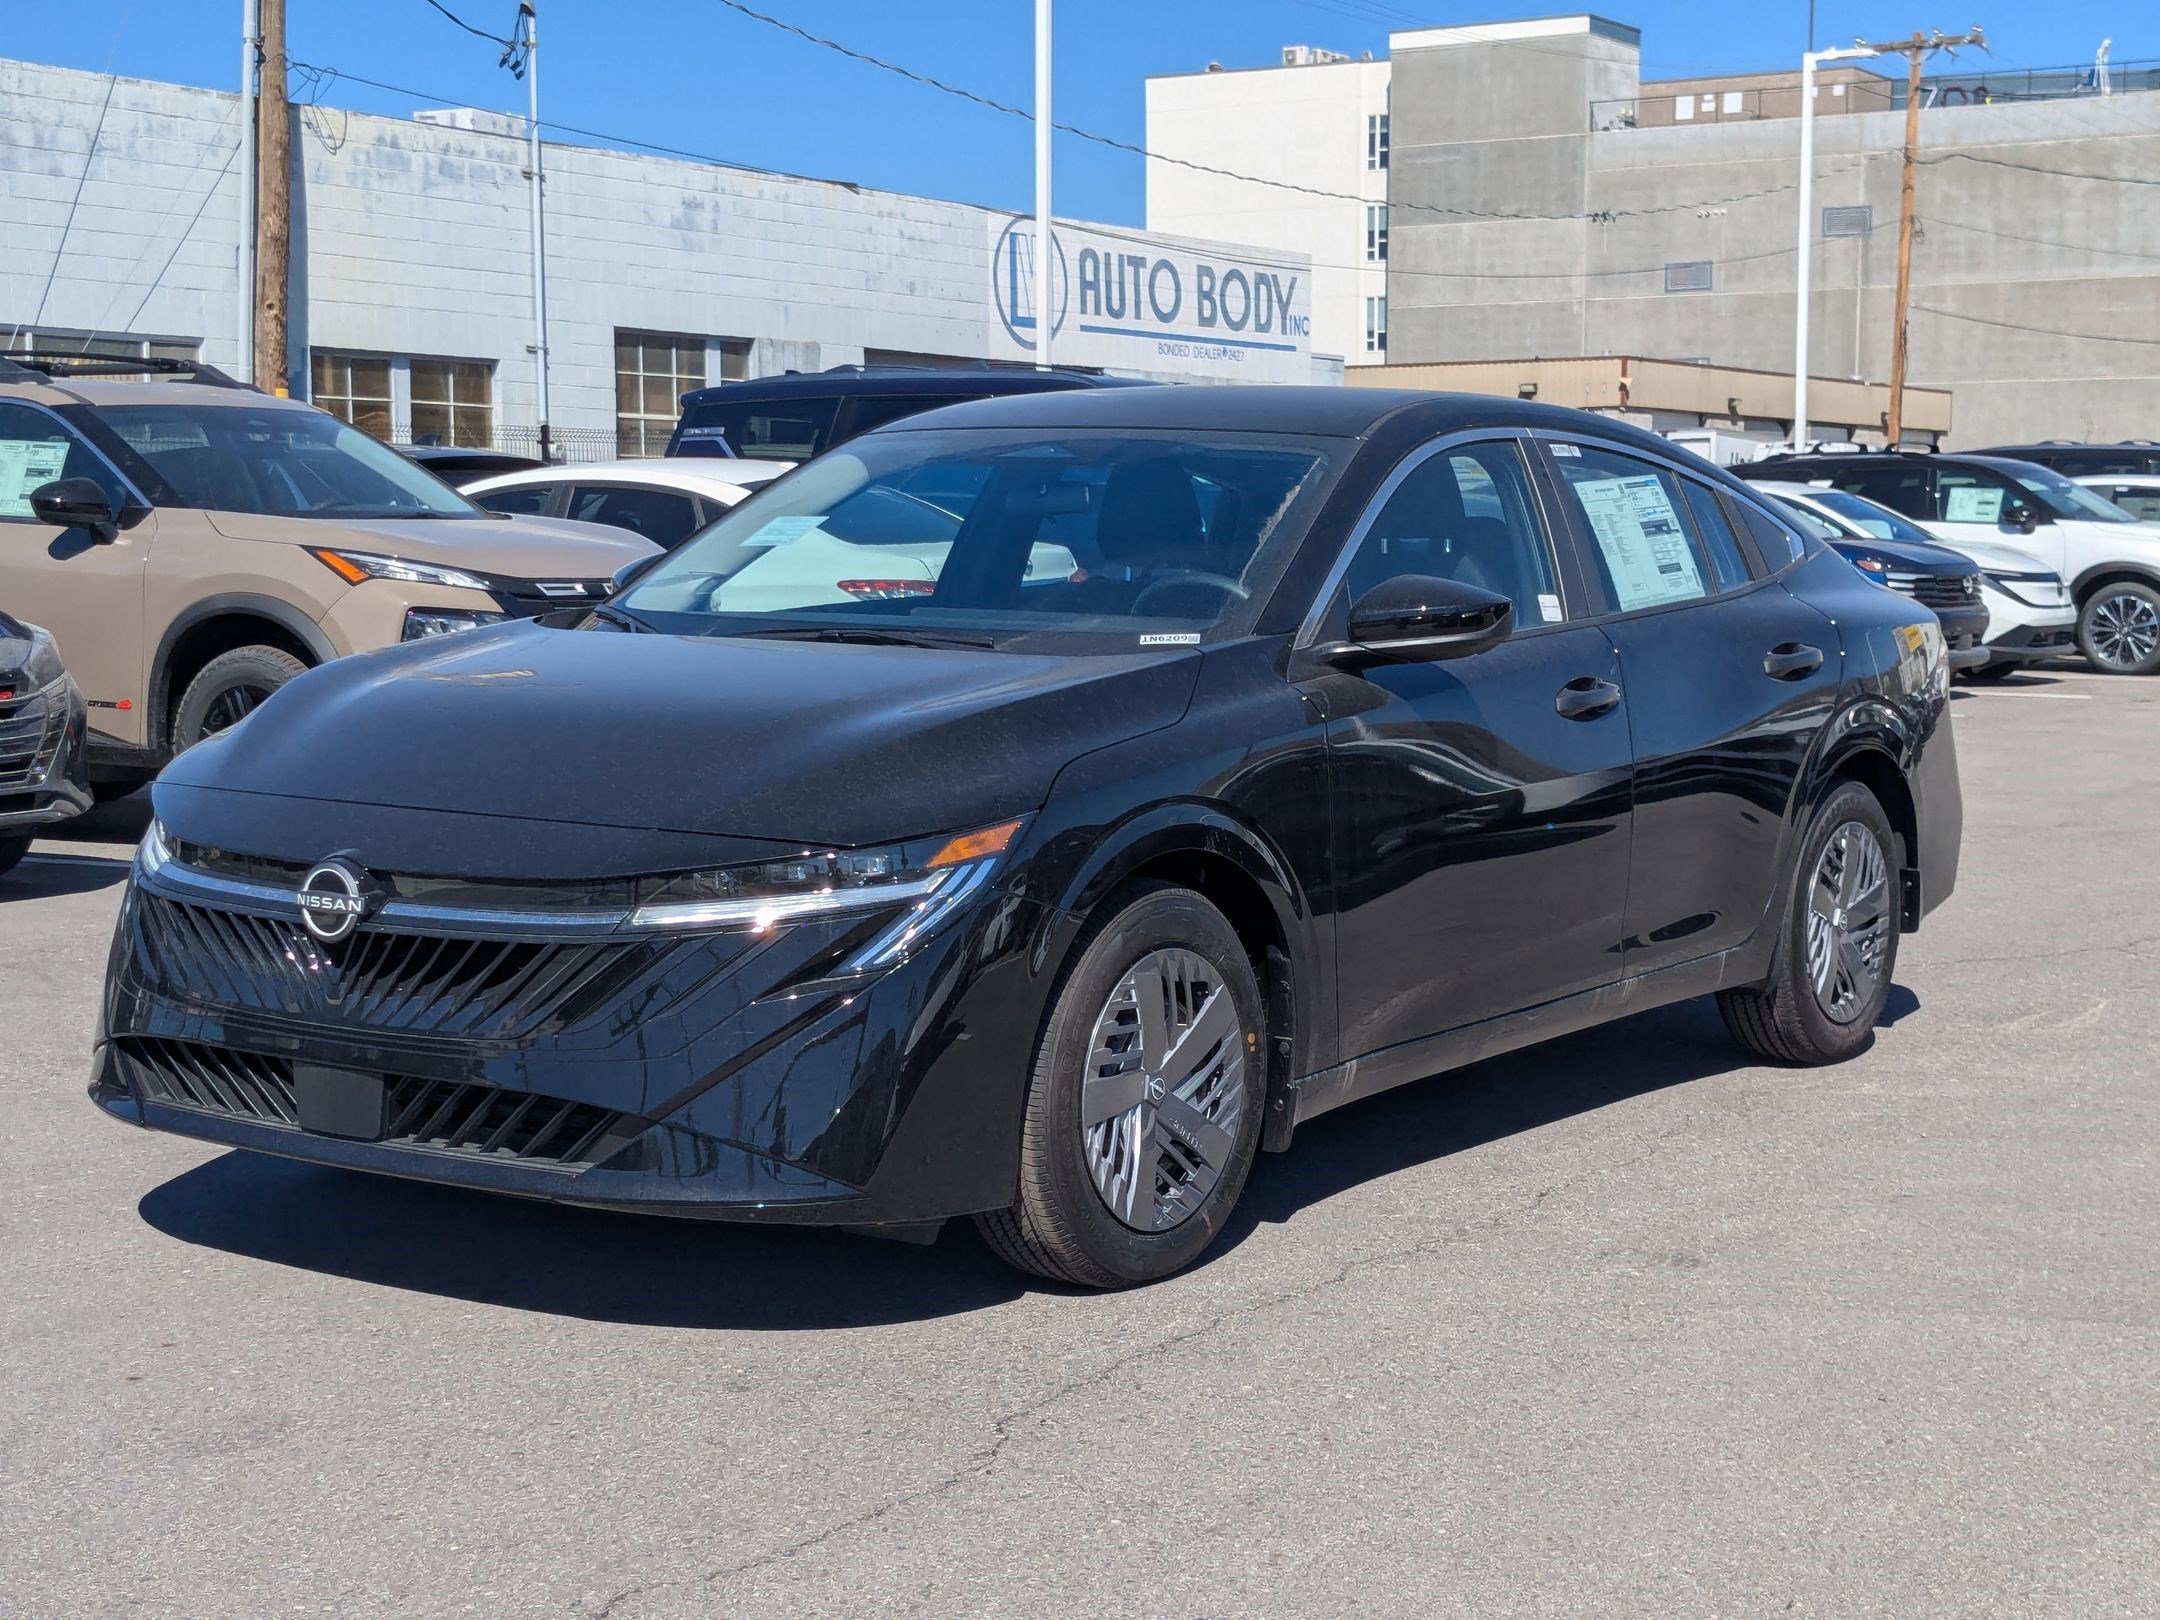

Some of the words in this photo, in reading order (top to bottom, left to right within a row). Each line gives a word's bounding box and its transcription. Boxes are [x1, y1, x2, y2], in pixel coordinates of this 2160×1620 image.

[1078, 247, 1182, 324] AUTO
[1196, 263, 1298, 335] BODY
[1288, 313, 1311, 338] INC
[1157, 341, 1191, 358] BONDED
[297, 892, 362, 912] NISSAN
